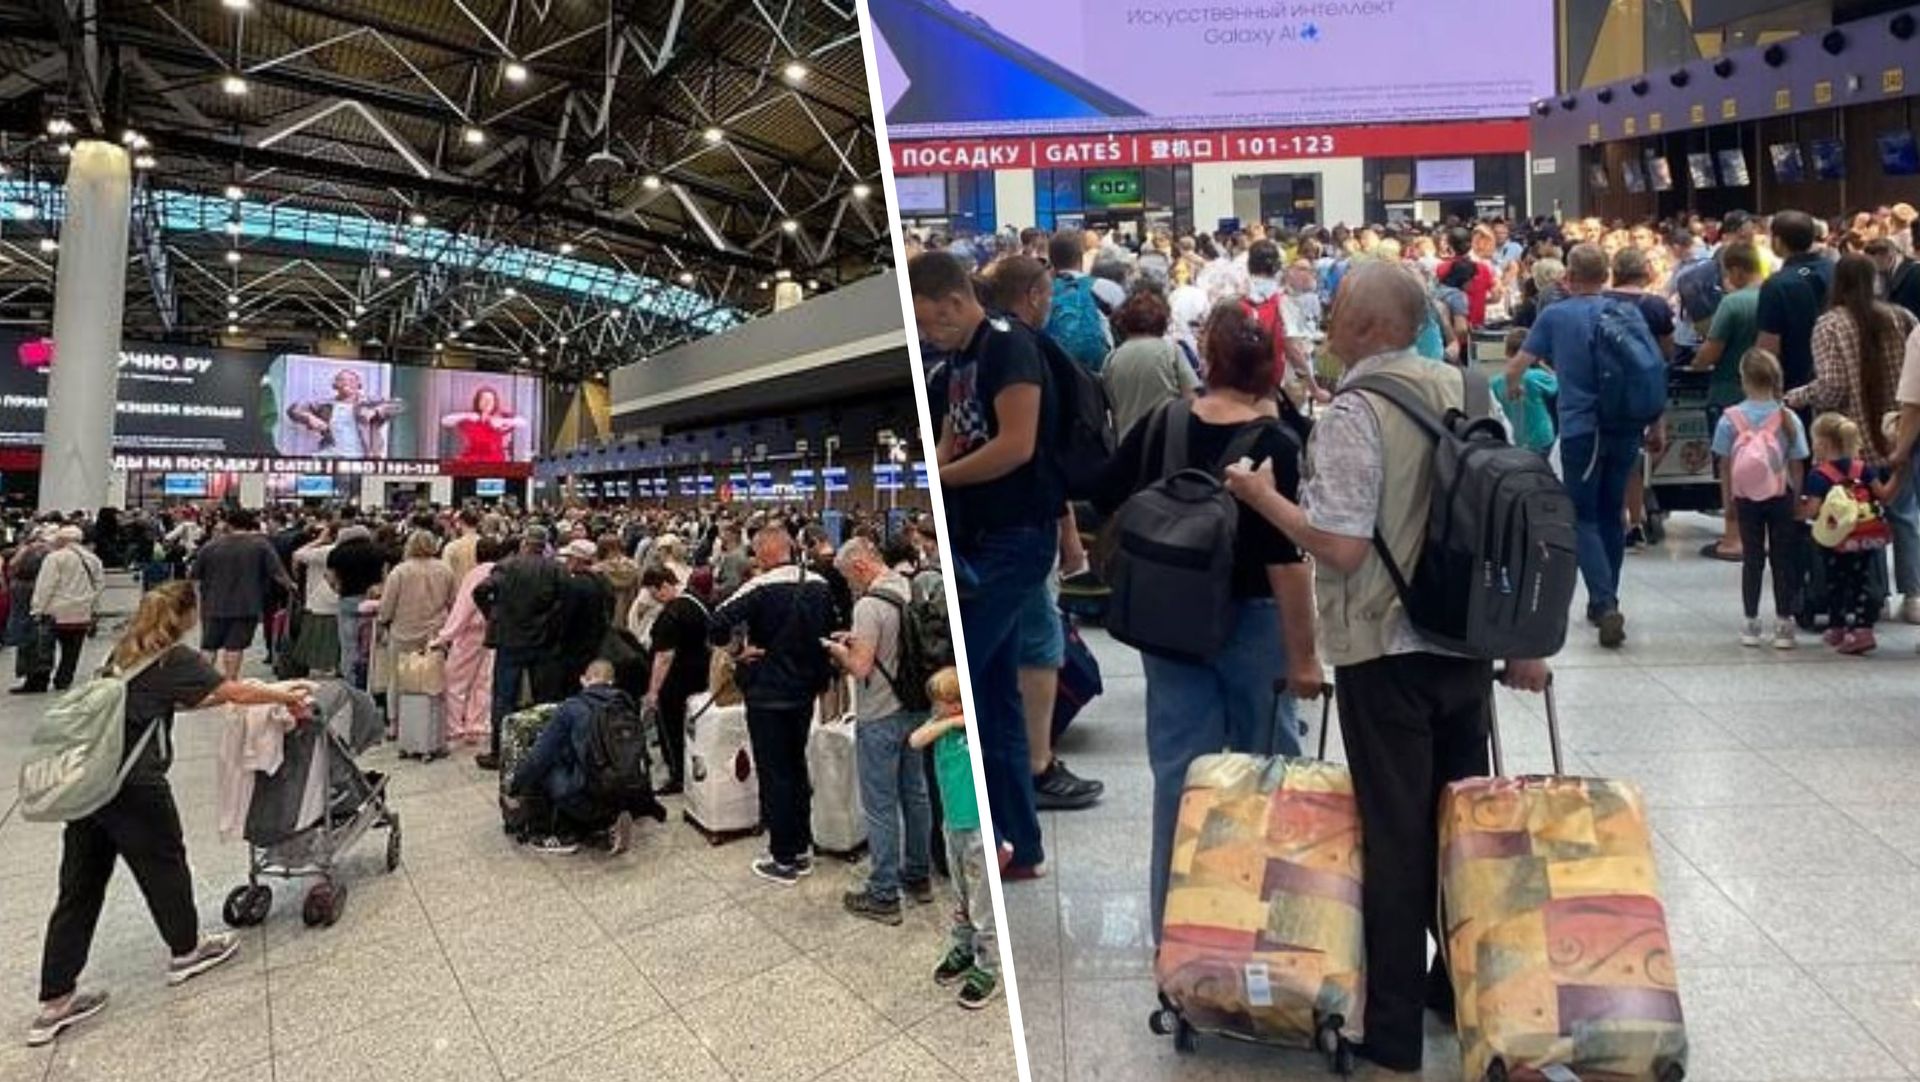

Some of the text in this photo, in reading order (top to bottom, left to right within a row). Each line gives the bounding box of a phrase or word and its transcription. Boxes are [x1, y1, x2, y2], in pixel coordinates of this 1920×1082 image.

[1127, 4, 1287, 27] Искусственный
[1204, 25, 1297, 46] Galaxy AI
[902, 145, 1020, 168] ПОСАДКУ
[1045, 143, 1121, 162] GATES
[1236, 134, 1335, 156] 101-123
[176, 456, 258, 471] ПОСАДКУ
